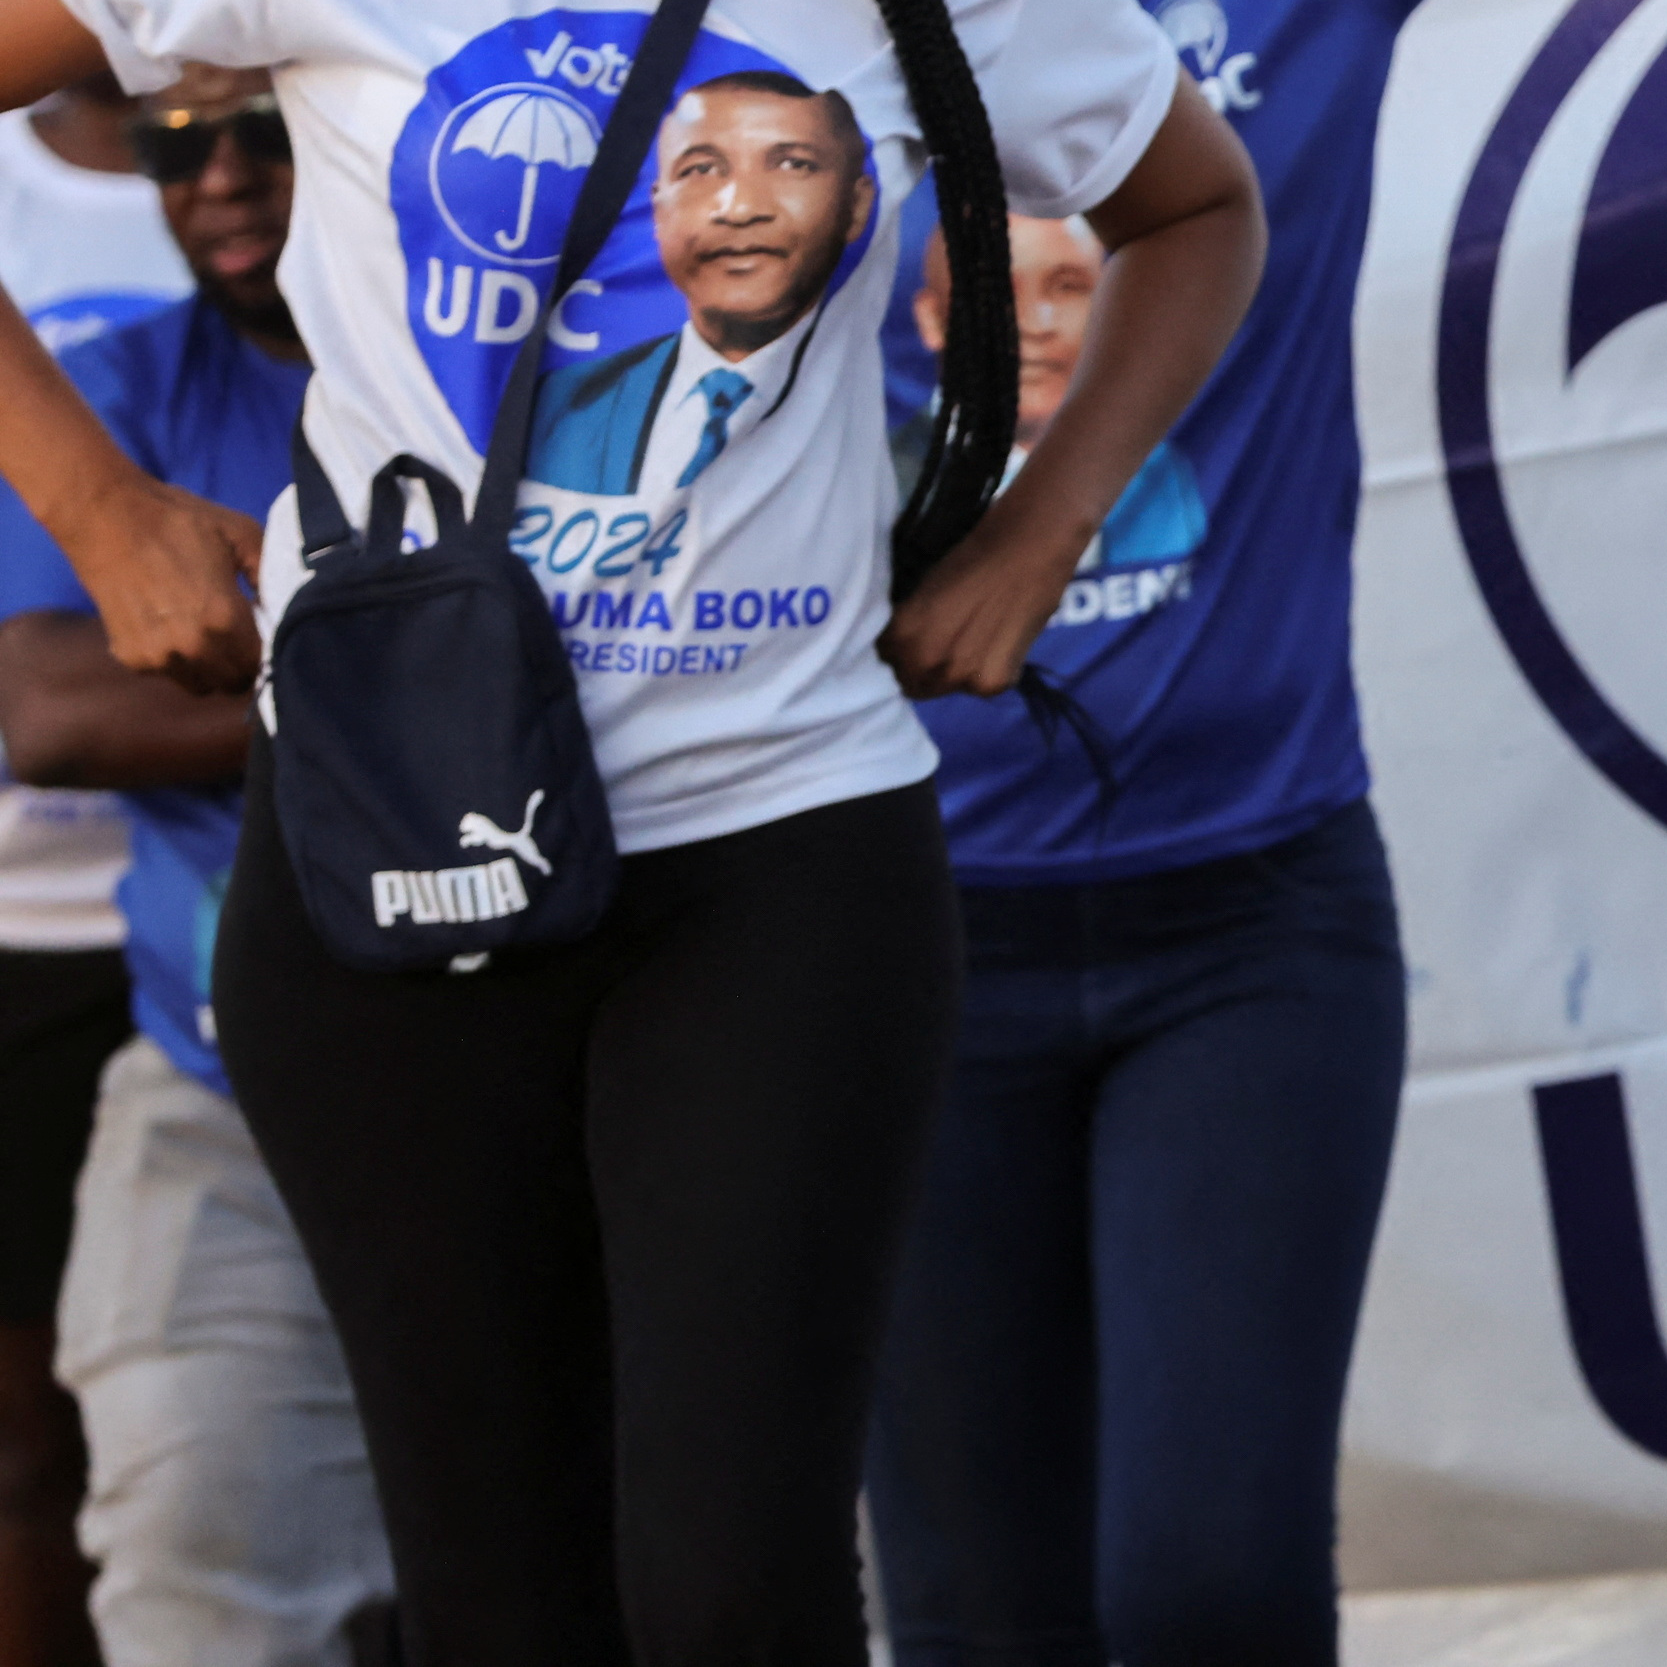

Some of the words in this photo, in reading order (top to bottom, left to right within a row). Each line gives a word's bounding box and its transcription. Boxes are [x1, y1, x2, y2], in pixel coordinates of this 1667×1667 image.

[424, 257, 603, 351] UDC
[508, 506, 688, 578] 2024
[552, 590, 673, 632] UMA
[693, 585, 831, 630] BOKO
[568, 640, 748, 675] RESIDENT
[371, 857, 528, 927] PUMA
